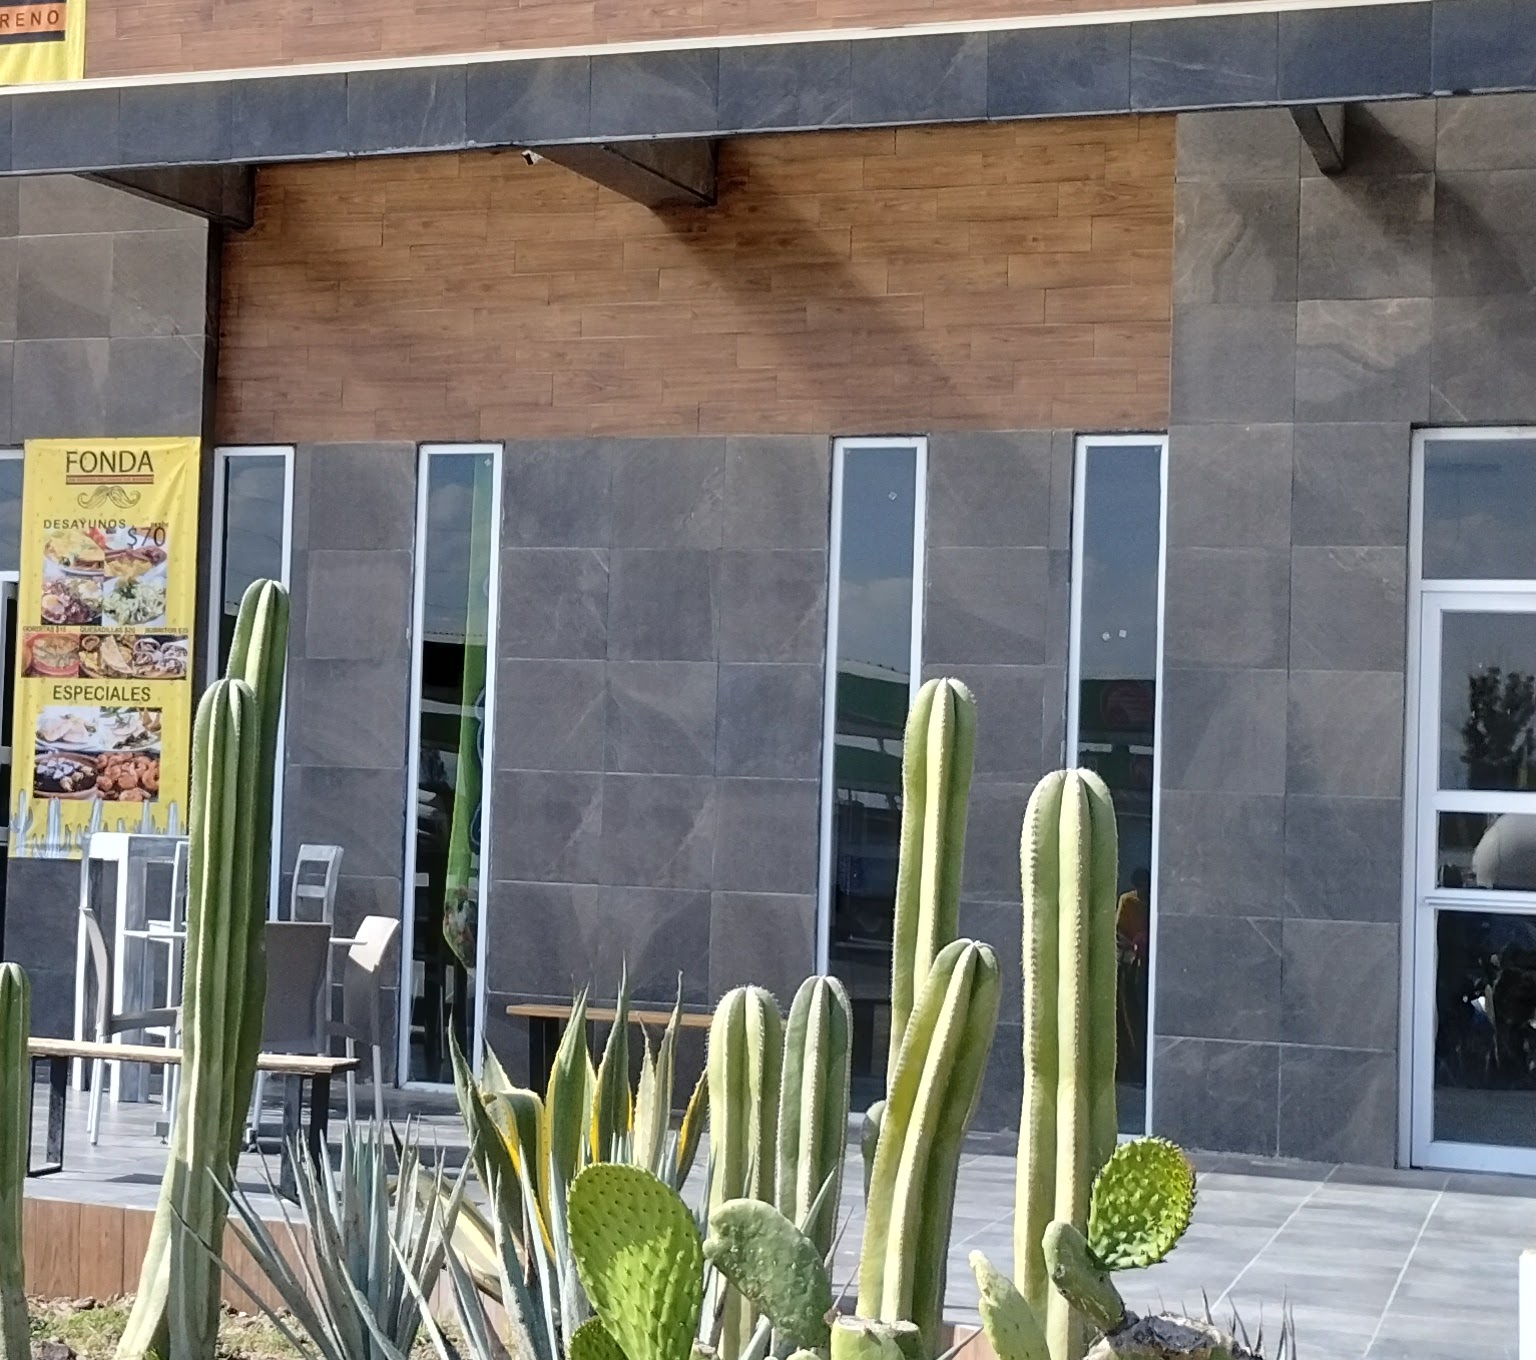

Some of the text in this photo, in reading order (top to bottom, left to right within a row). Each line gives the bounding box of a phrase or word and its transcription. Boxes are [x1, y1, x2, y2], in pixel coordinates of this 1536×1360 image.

[65, 450, 154, 473] FONDA
[43, 518, 126, 530] DESAYUNOS
[127, 525, 167, 548] $70
[52, 685, 151, 702] ESPECIALES
